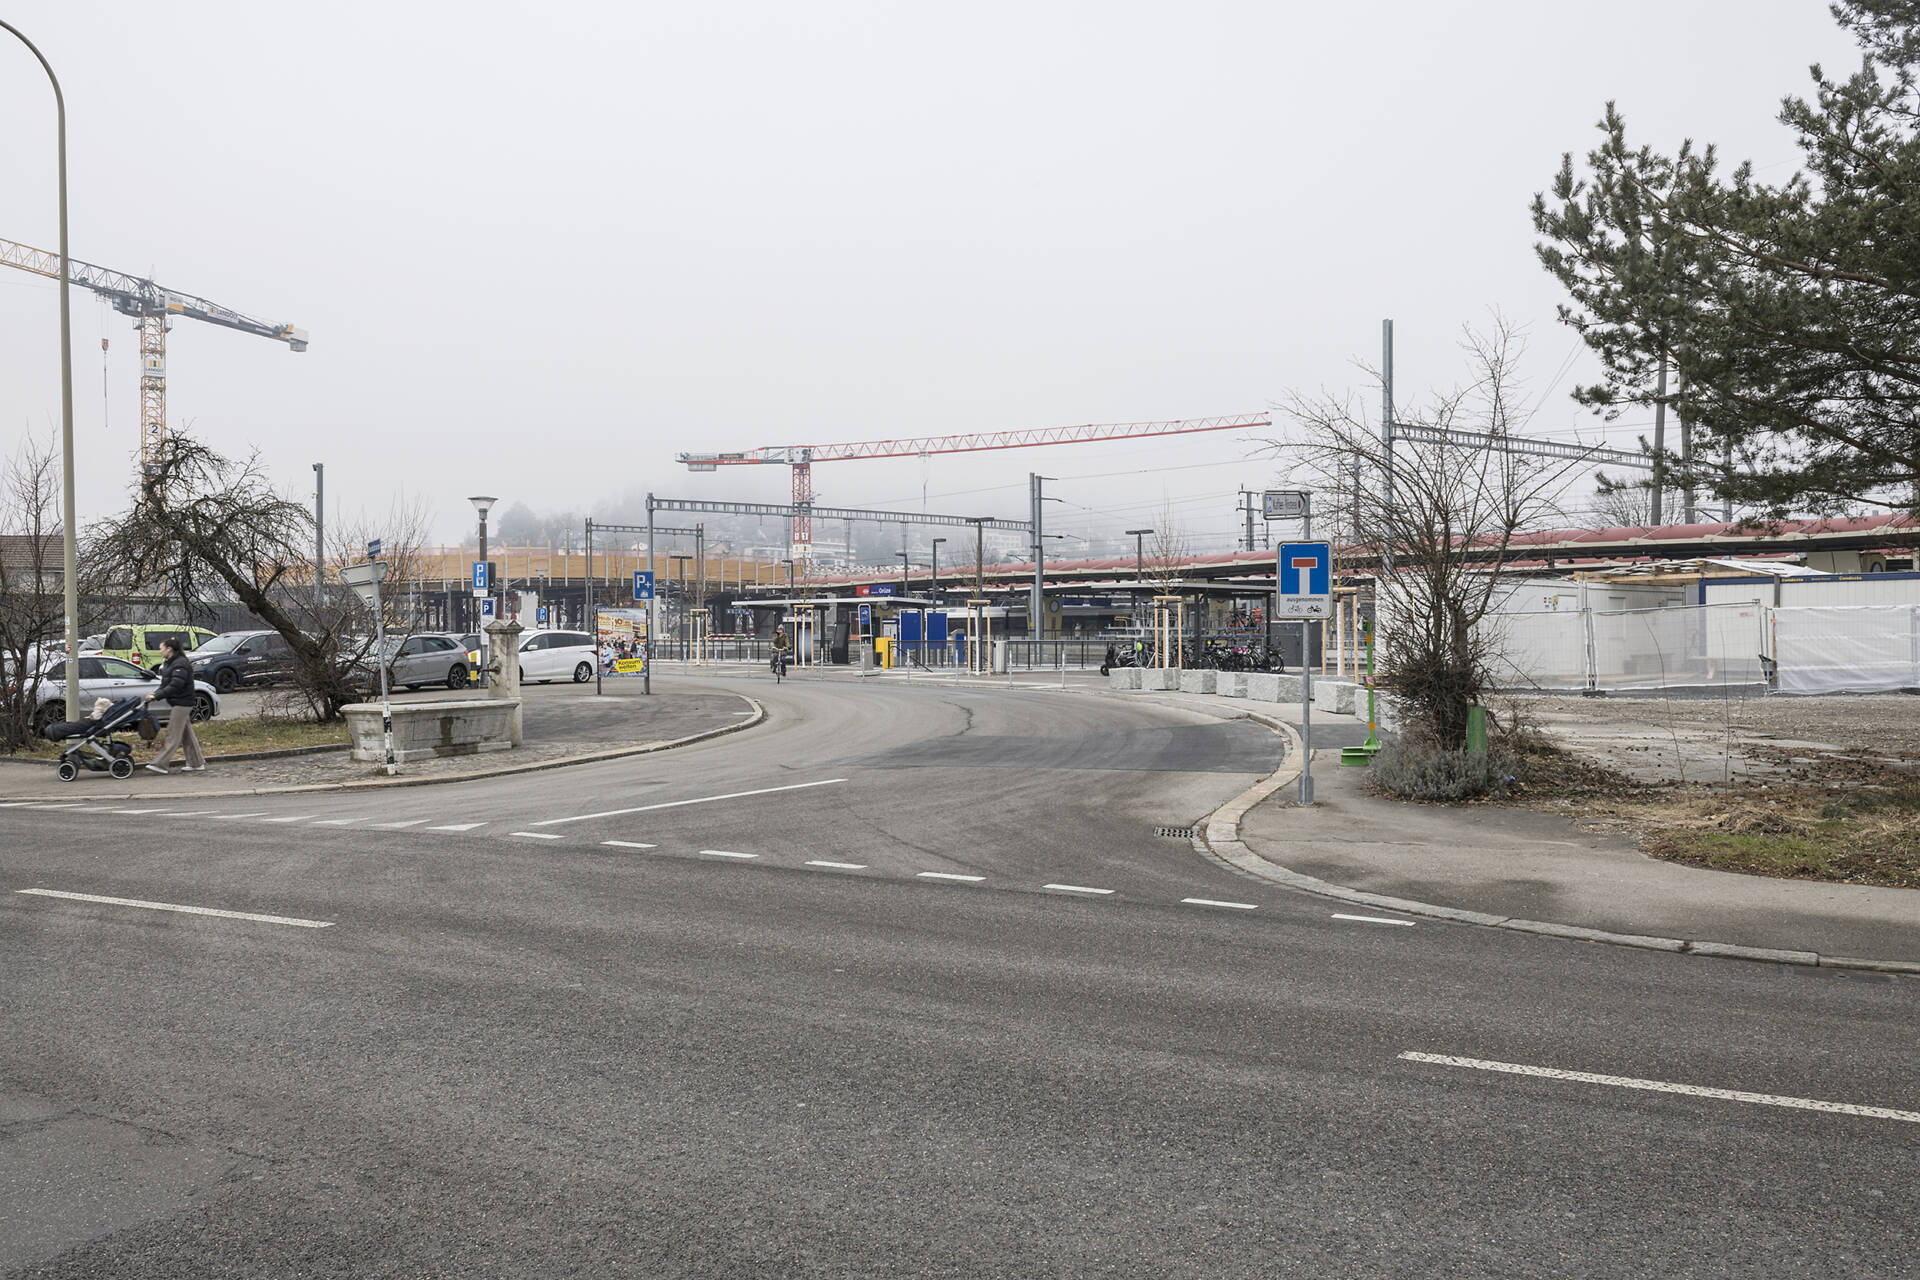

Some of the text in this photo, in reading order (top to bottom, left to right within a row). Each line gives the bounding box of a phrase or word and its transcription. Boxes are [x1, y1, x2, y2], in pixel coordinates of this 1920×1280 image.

[151, 424, 159, 434] 2
[476, 564, 484, 577] P
[483, 604, 490, 613] P
